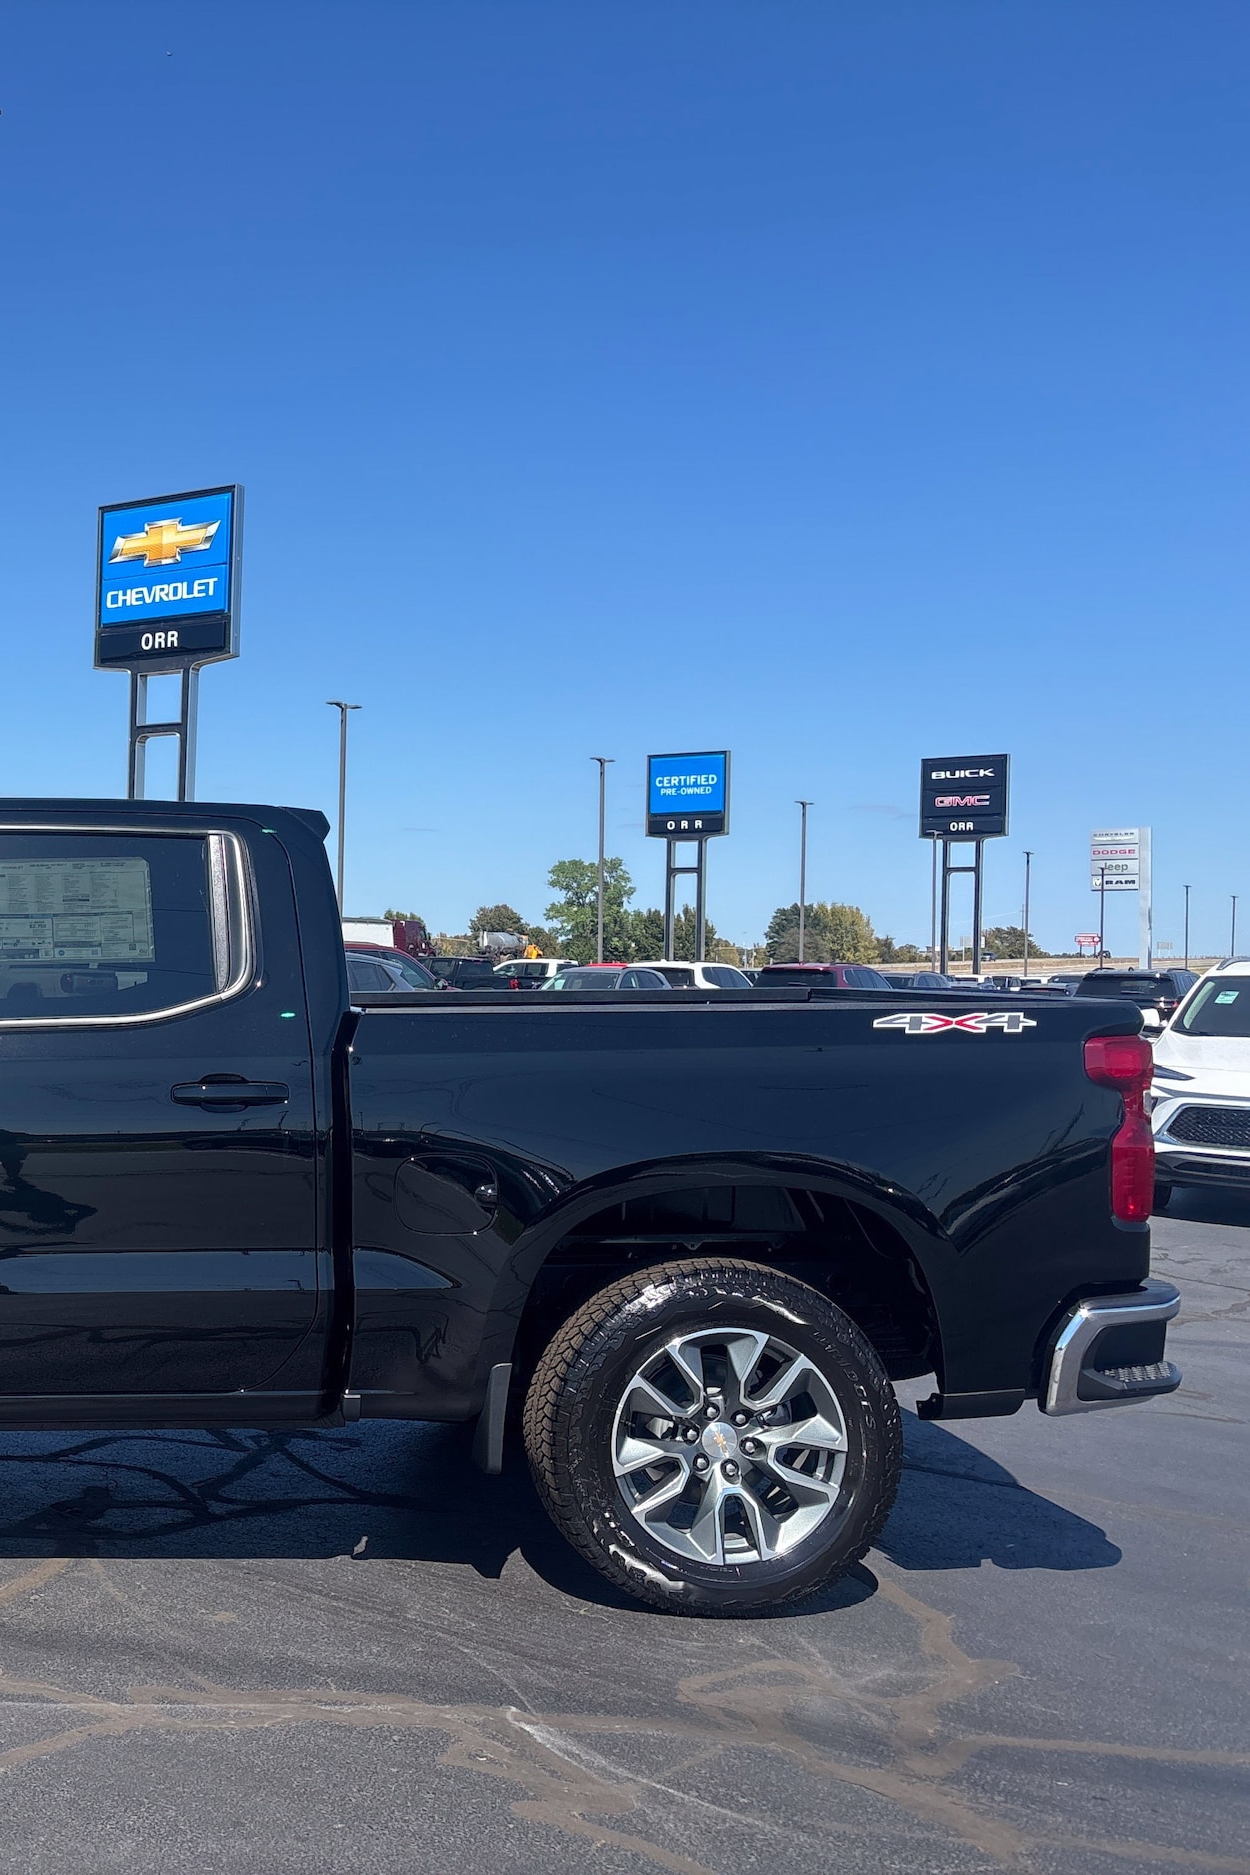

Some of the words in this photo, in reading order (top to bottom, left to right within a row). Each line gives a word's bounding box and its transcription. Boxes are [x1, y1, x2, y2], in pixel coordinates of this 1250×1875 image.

[106, 577, 218, 608] CHEVROLET
[141, 630, 179, 650] ORR
[931, 768, 995, 779] BUICK
[655, 774, 717, 787] CERTIFIED
[660, 786, 712, 796] PRE-OWNED
[934, 795, 990, 807] GMC
[666, 819, 703, 830] ORR
[950, 821, 974, 831] ORR
